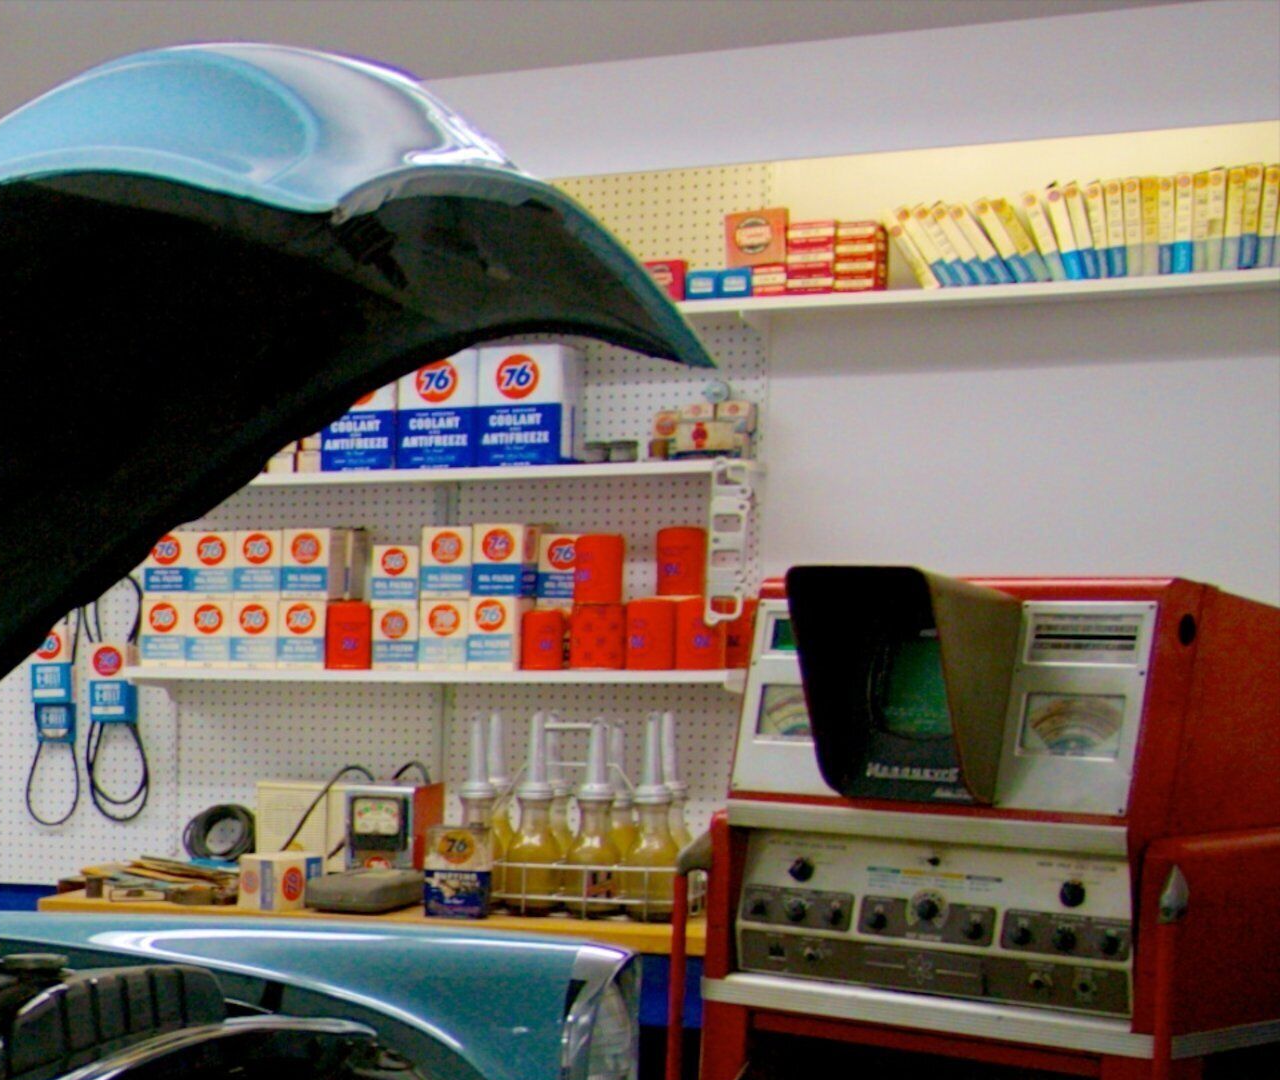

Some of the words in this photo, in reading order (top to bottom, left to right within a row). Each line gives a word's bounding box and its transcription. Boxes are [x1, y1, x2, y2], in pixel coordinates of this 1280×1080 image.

[424, 368, 450, 391] 76
[504, 364, 531, 387] 76
[330, 419, 381, 433] COOLANT
[408, 416, 460, 431] COOLANT
[488, 413, 543, 427] COOLANT
[324, 436, 389, 451] ANTIFREEZE
[402, 433, 468, 448] ANTIFREEZE
[482, 430, 550, 445] ANTIFREEZE
